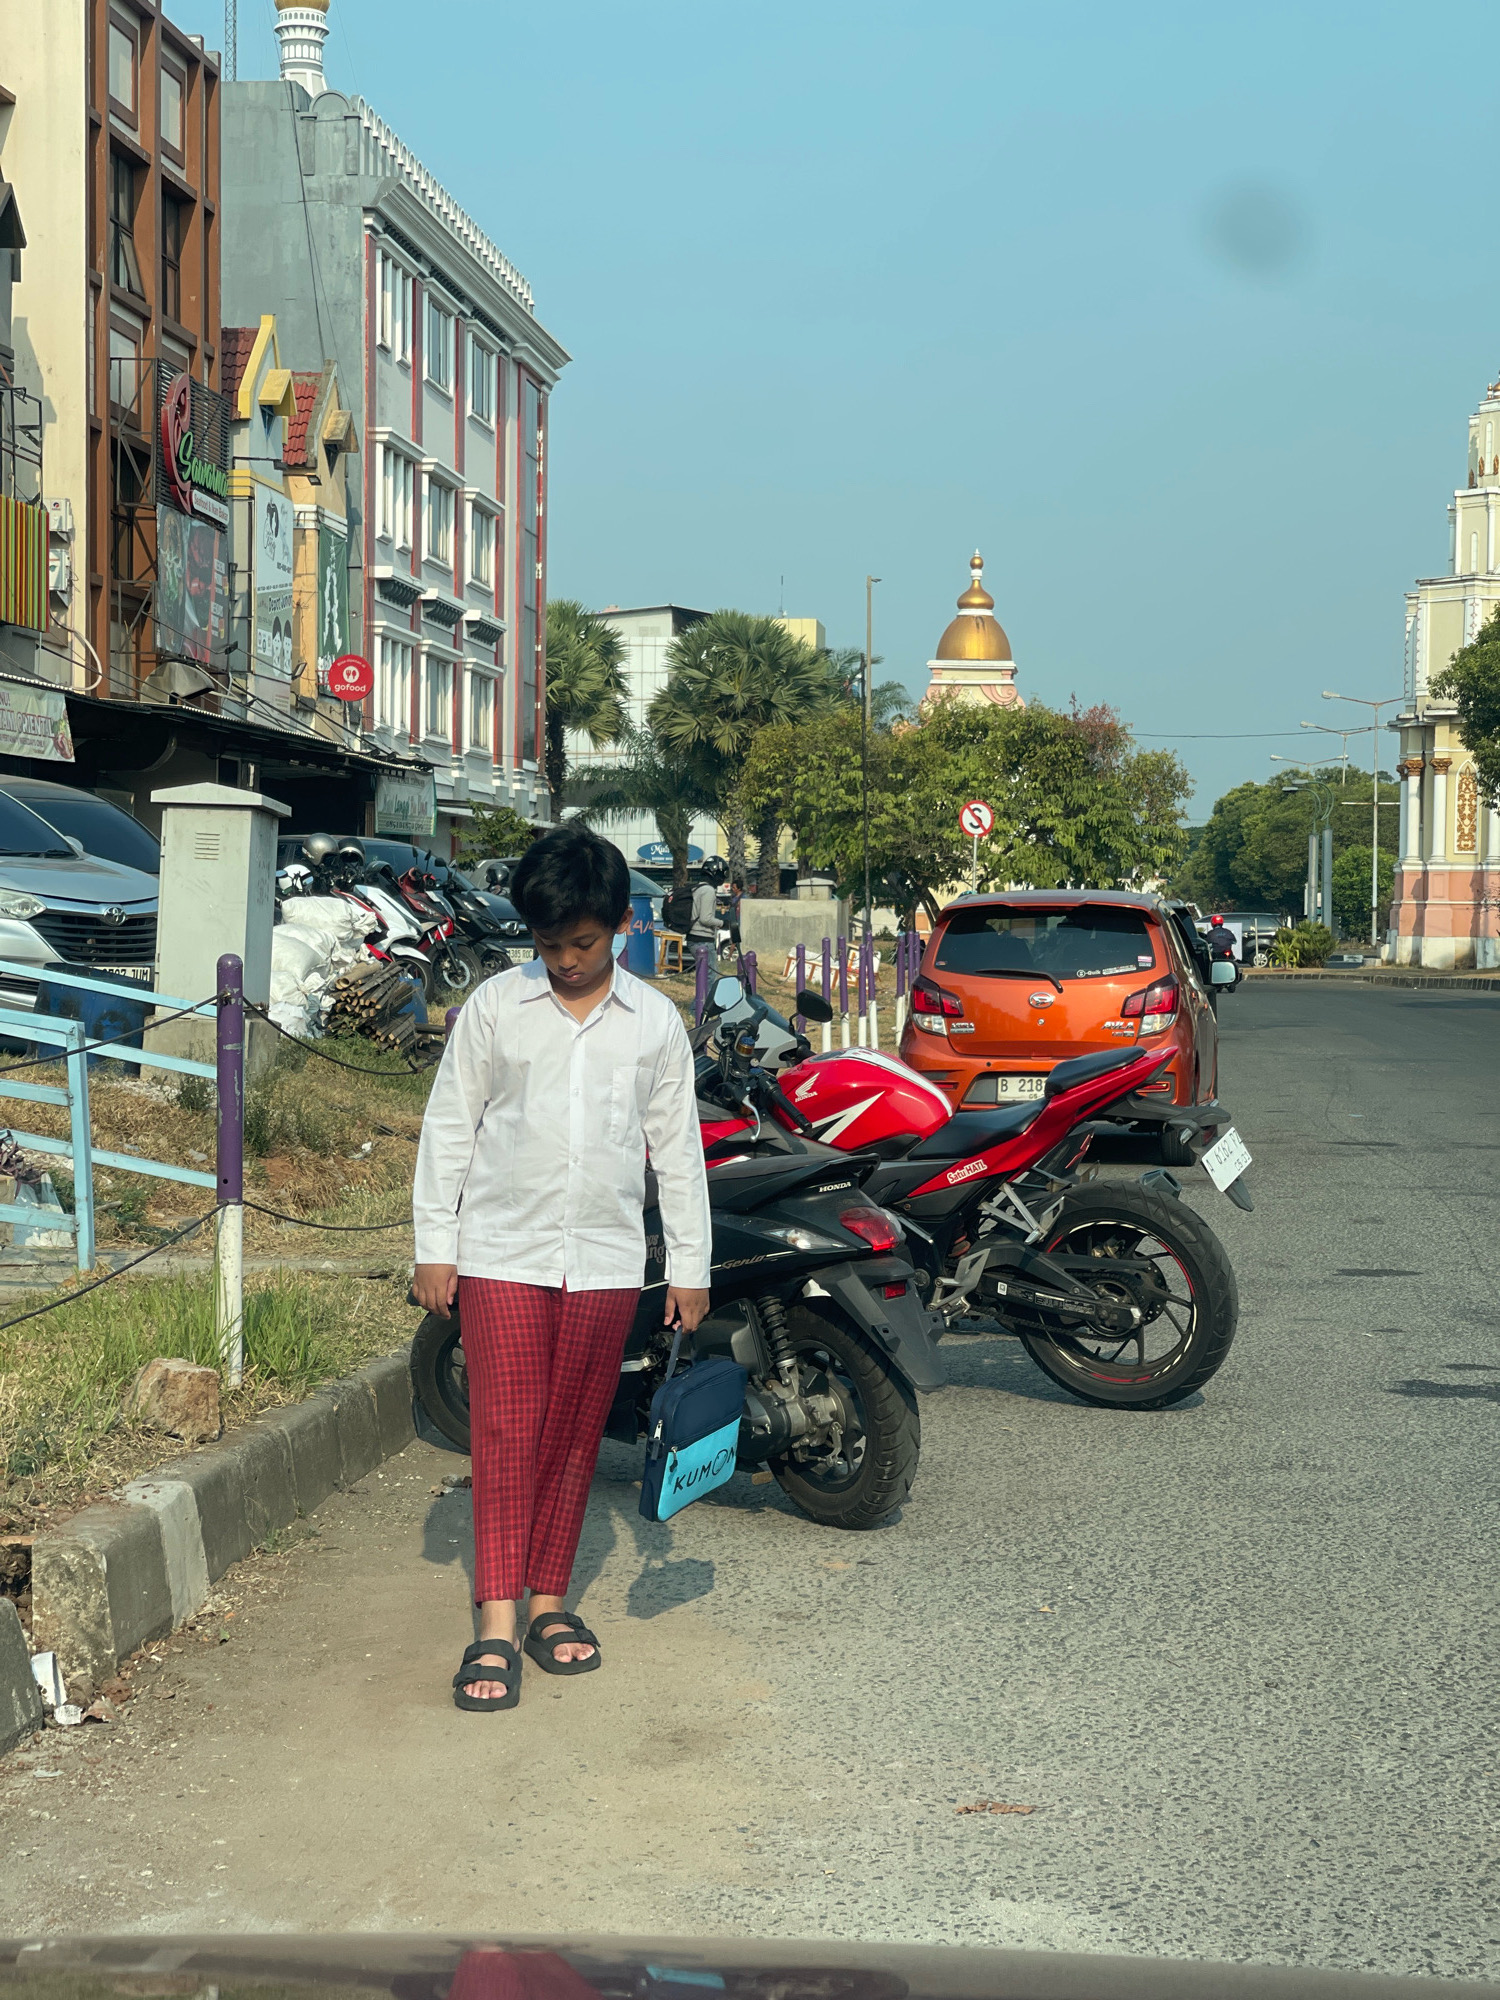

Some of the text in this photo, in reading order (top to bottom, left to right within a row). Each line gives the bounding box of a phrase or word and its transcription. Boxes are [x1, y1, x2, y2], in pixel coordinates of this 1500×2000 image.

[334, 684, 366, 692] gofood
[1000, 1079, 1046, 1092] B 218
[795, 1091, 818, 1103] HONDA
[1213, 1139, 1233, 1165] 6162
[948, 1169, 967, 1182] Satu
[819, 1181, 852, 1193] HONDA
